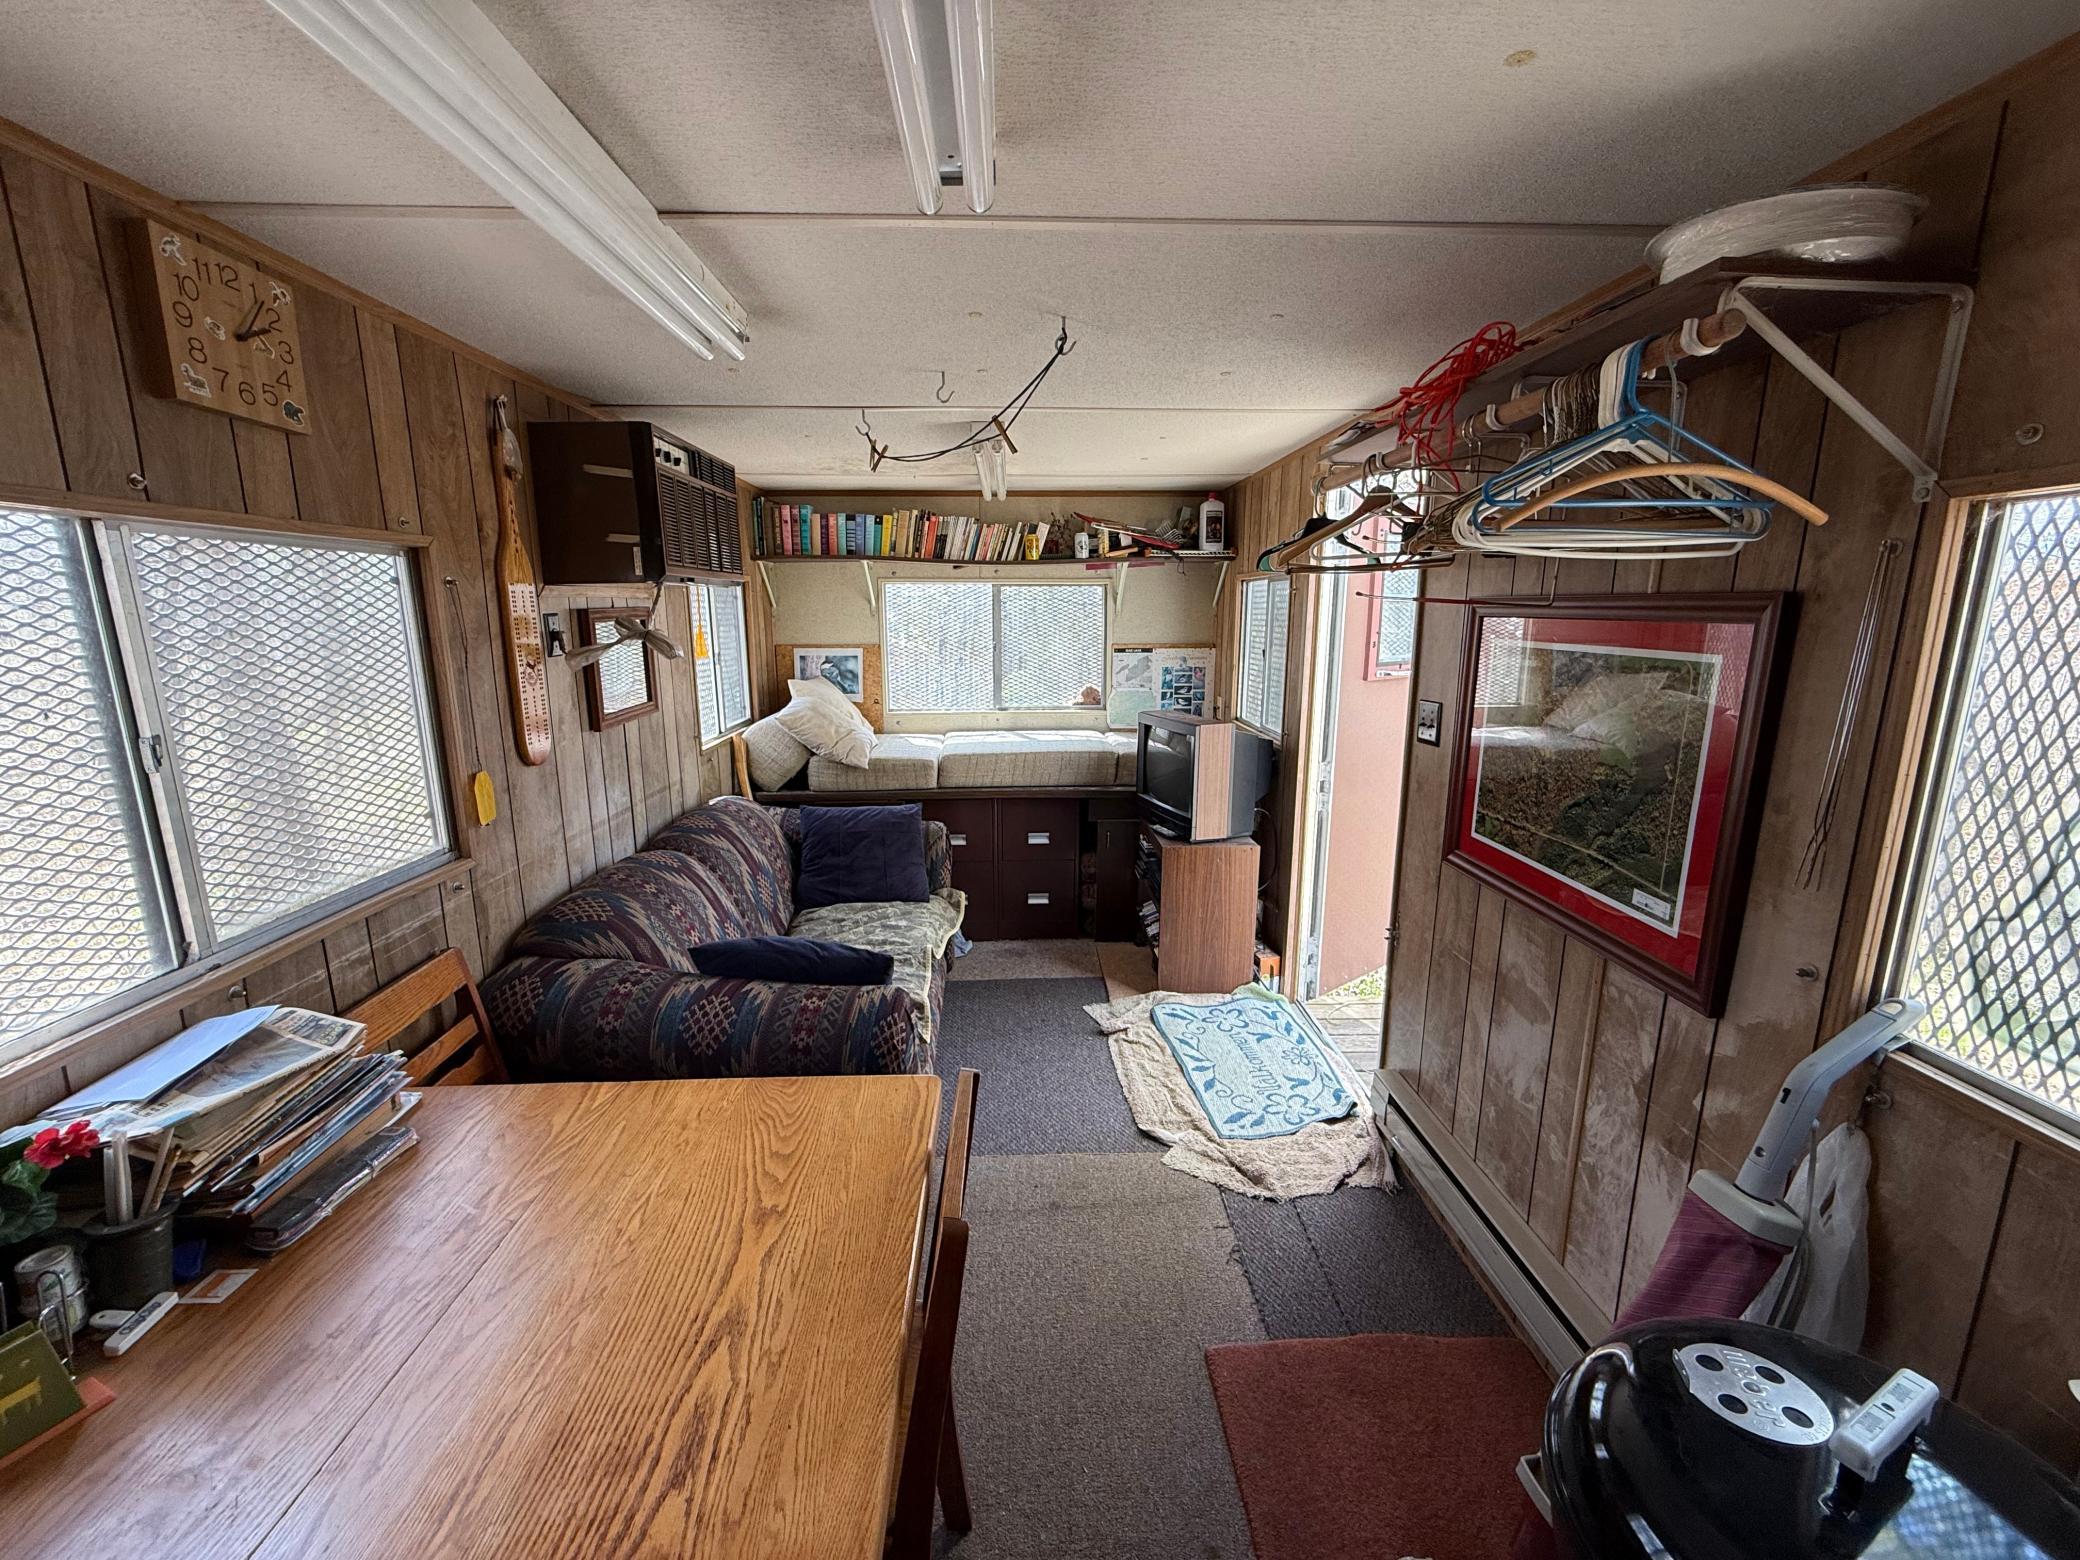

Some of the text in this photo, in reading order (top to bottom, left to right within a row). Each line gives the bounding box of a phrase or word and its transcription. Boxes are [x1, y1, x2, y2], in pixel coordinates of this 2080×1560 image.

[192, 257, 212, 286] 11
[215, 262, 241, 292] 12
[173, 273, 200, 302] 10
[249, 283, 259, 304] 1
[172, 301, 193, 328] 9
[265, 308, 282, 333] 2
[188, 337, 207, 364] 8
[278, 340, 294, 365] 3
[211, 367, 230, 392] 7
[276, 370, 293, 393] 4
[238, 381, 256, 406] 6
[262, 383, 279, 407] 5
